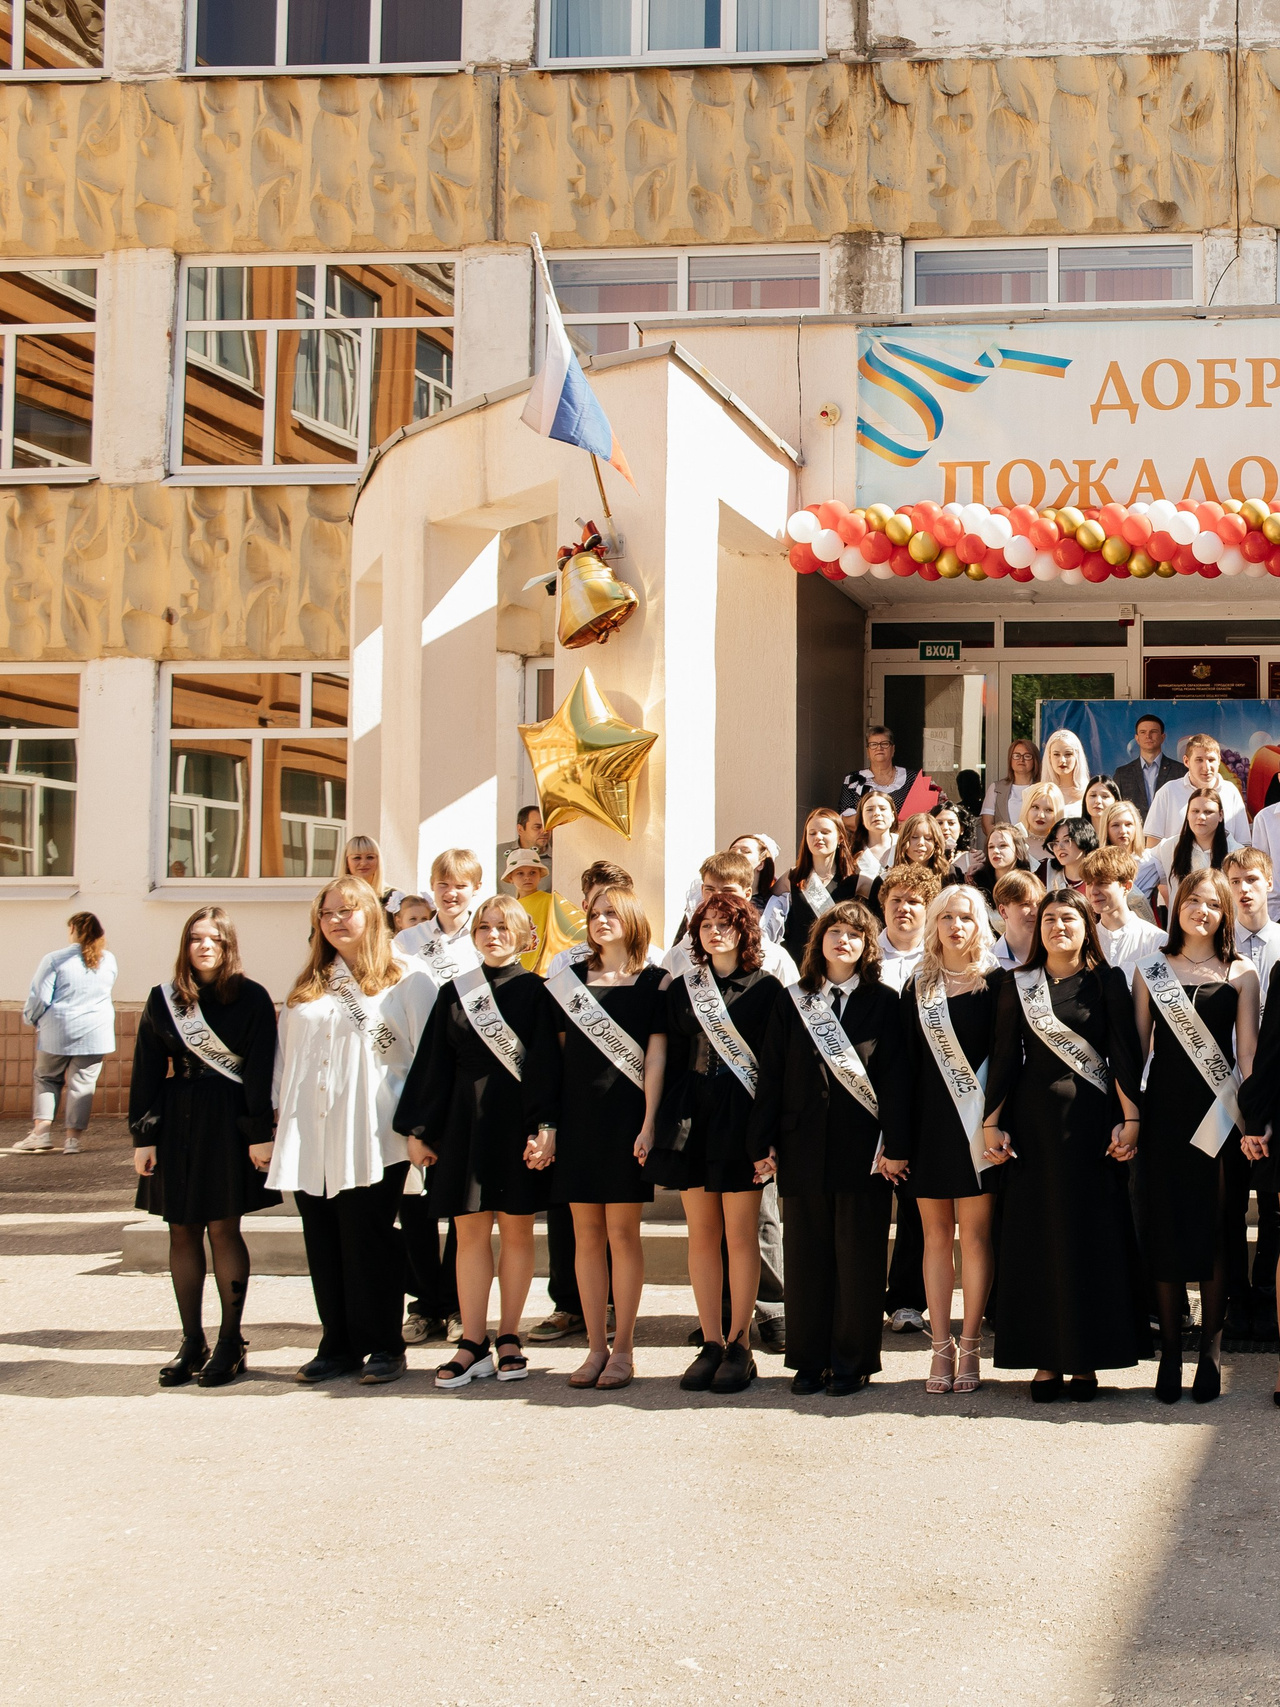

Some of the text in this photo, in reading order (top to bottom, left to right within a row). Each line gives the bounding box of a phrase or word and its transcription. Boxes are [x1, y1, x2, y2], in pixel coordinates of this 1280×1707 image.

[925, 645, 955, 659] ВХОД
[368, 1022, 397, 1049] 2025
[474, 1011, 525, 1068] Выпускн
[693, 989, 744, 1066] Выпускник
[1028, 1004, 1092, 1074] Выпускник
[1153, 979, 1231, 1081] Выпускник 2025
[950, 1066, 978, 1094] 2025
